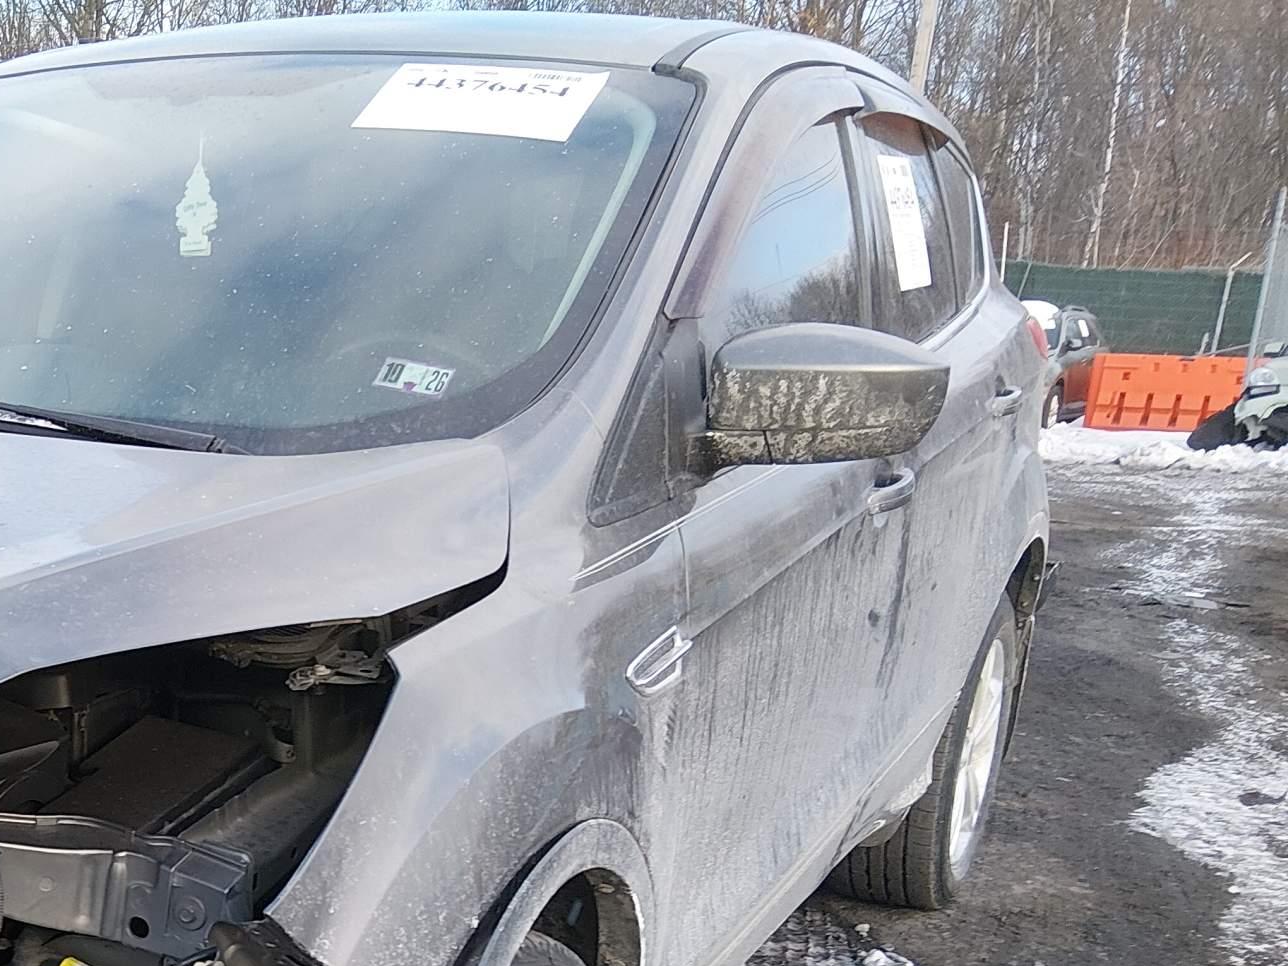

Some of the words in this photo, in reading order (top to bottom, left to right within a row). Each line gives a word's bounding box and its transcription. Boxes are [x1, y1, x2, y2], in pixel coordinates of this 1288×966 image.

[407, 77, 570, 97] 44376454
[382, 362, 406, 383] 10
[425, 370, 449, 392] 26
